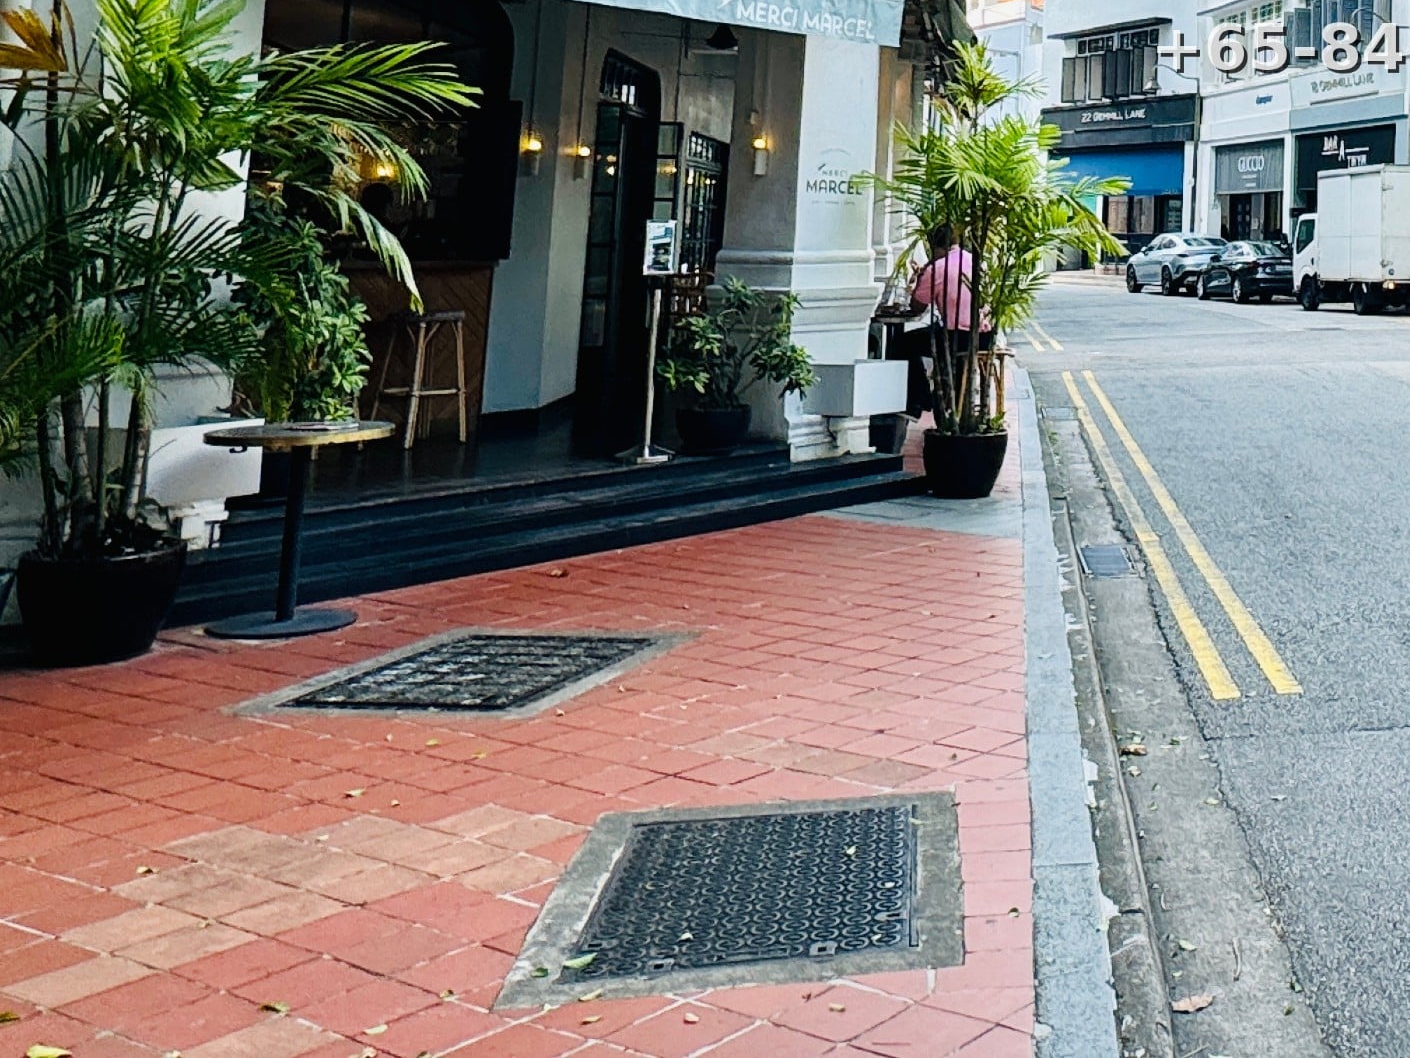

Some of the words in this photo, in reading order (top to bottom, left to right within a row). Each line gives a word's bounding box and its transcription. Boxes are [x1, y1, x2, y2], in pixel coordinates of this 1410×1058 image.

[735, 0, 799, 26] MERCI
[802, 11, 875, 40] MARCEL
[1081, 112, 1092, 123] 22
[1124, 107, 1146, 120] LANE
[806, 179, 863, 195] MARCEL
